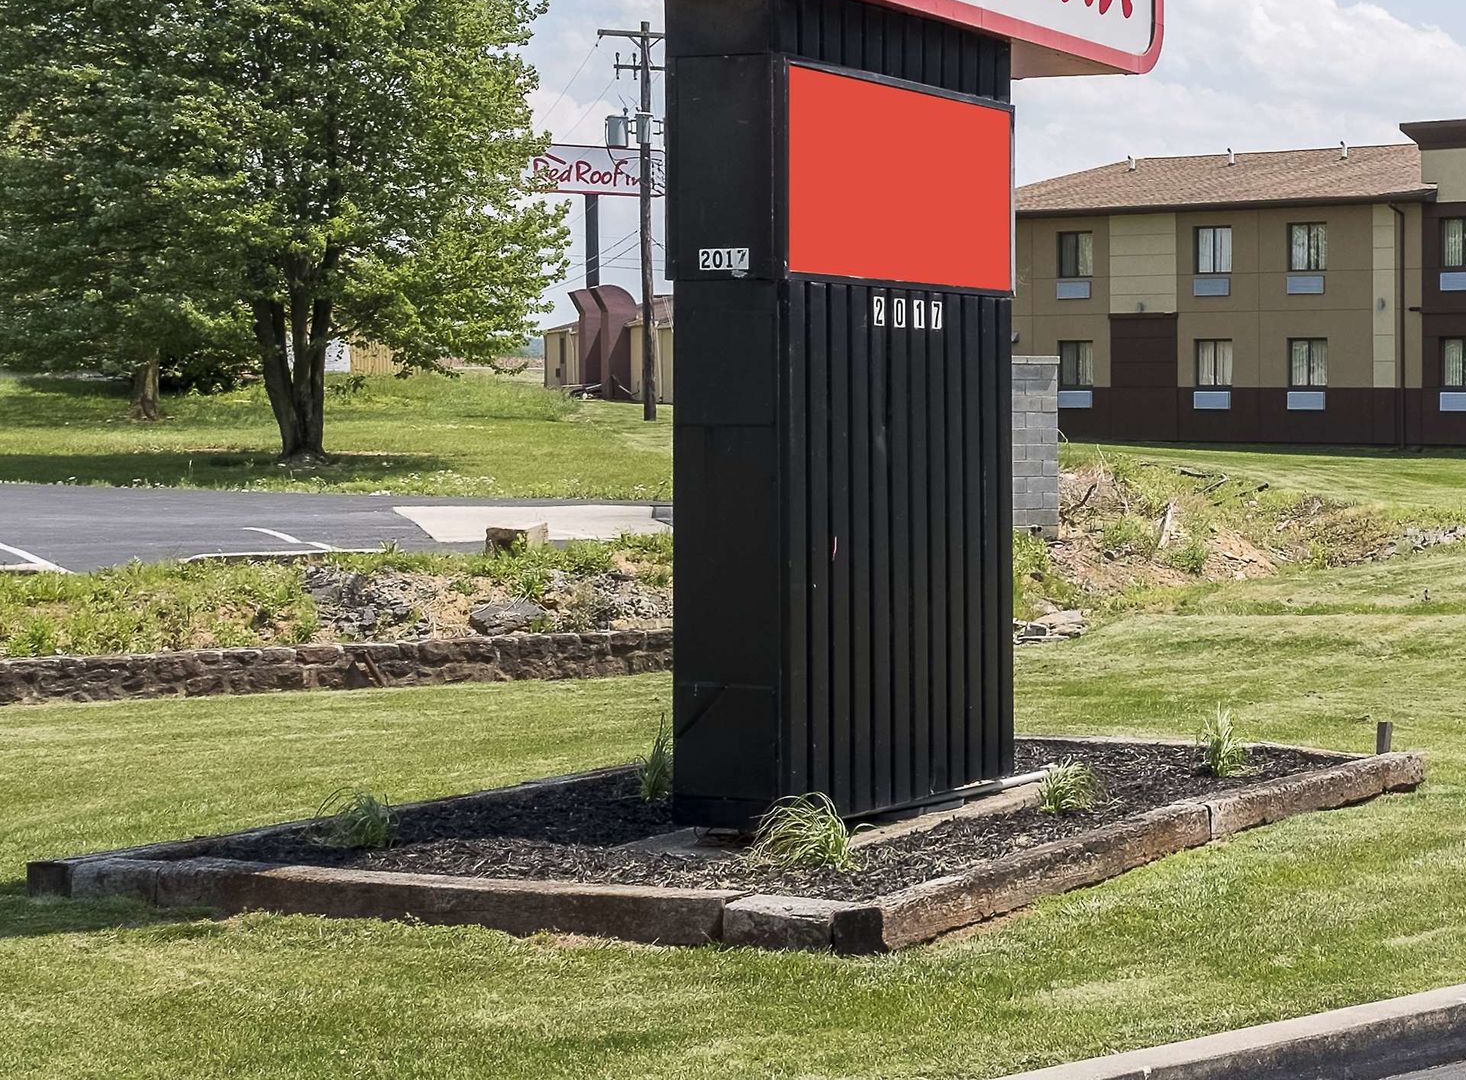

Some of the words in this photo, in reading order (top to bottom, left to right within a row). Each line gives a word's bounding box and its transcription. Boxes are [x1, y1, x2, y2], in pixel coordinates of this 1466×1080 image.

[575, 159, 628, 187] Roof
[701, 249, 747, 269] 2017
[874, 298, 942, 329] 2017
